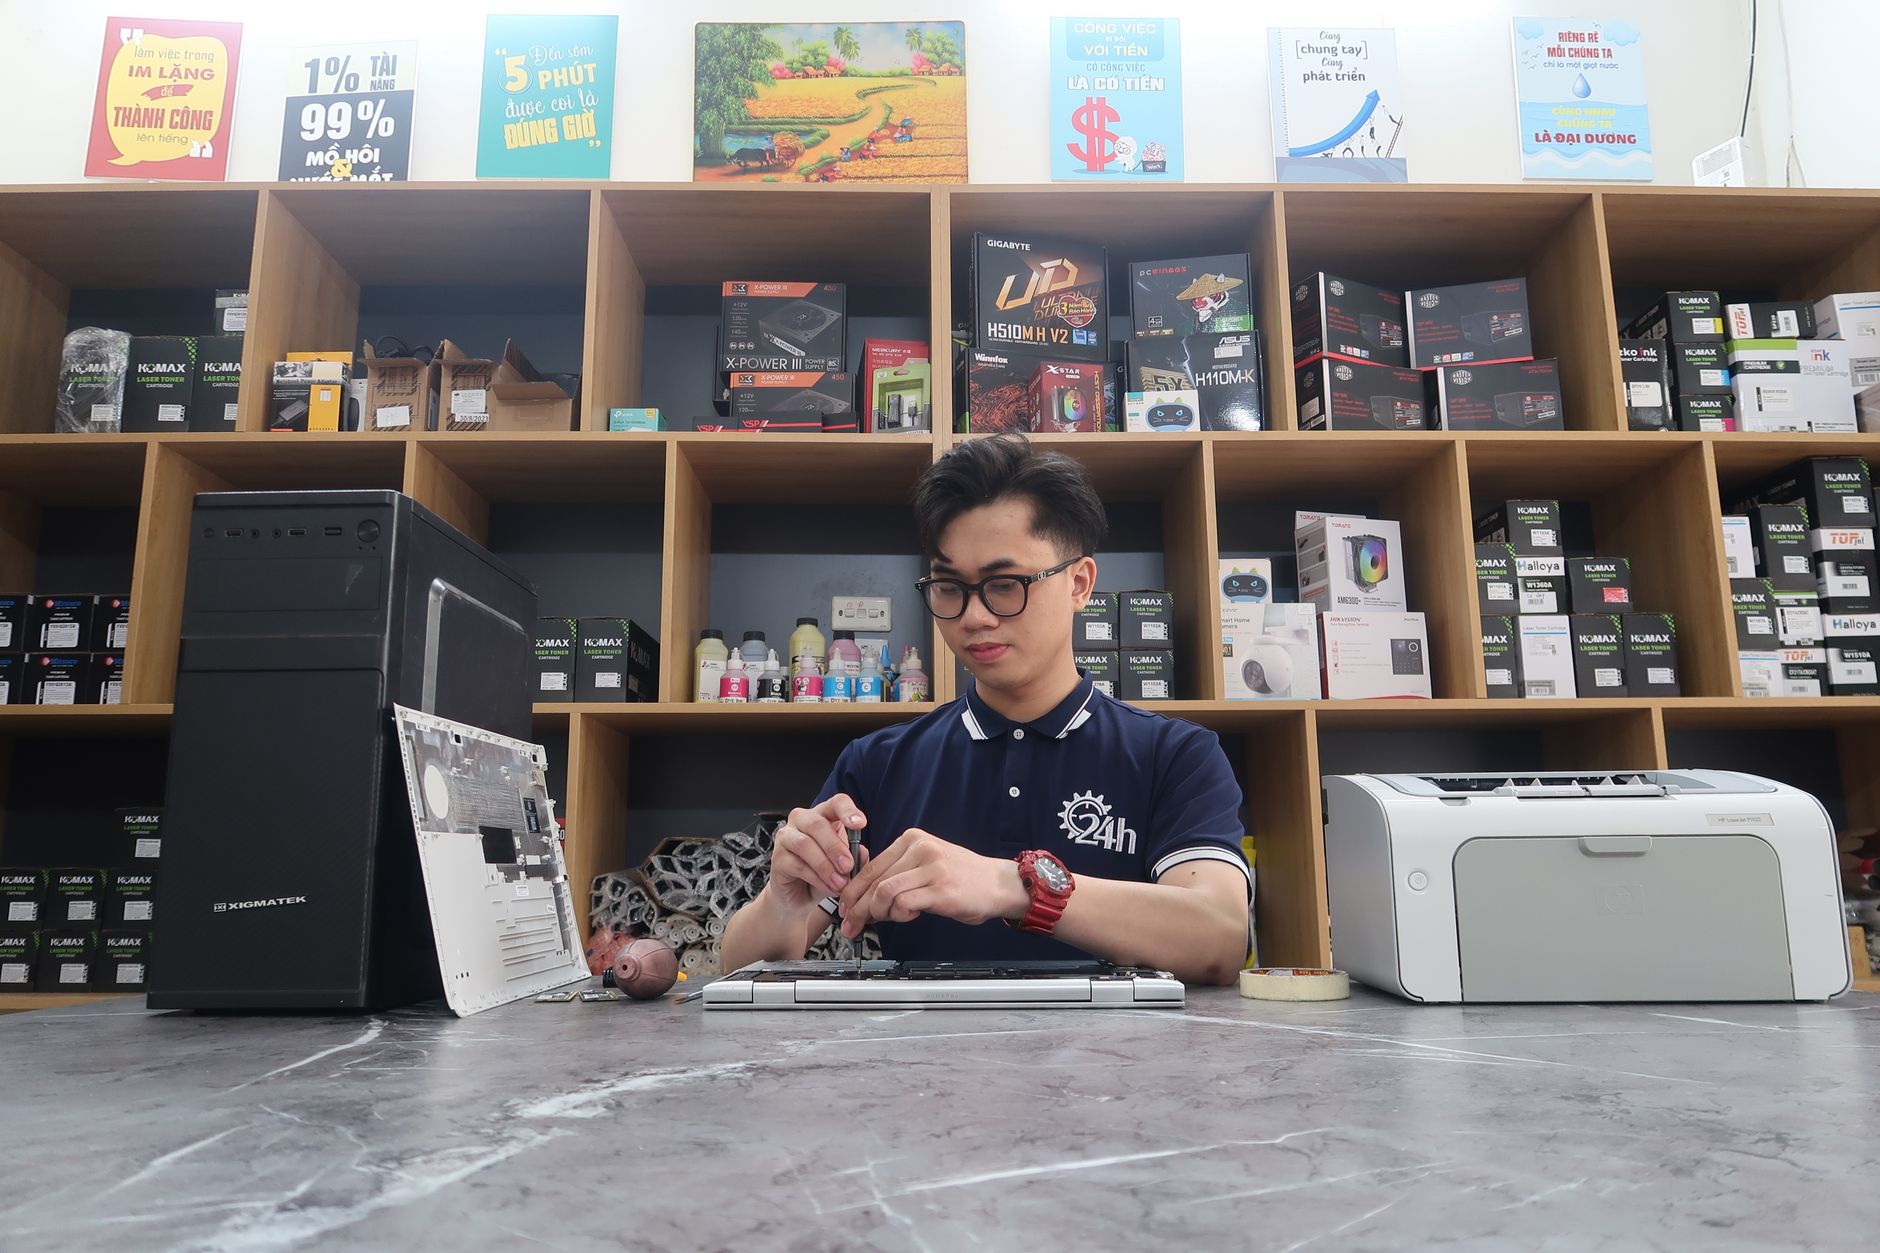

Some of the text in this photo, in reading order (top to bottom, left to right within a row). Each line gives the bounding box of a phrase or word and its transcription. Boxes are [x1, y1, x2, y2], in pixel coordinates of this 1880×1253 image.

[1073, 20, 1117, 33] CÔNG
[1558, 31, 1585, 43] RIÊNG
[1568, 46, 1599, 58] CHÚNG
[1602, 48, 1613, 59] TA
[128, 63, 215, 82] IM LẶNG
[304, 51, 398, 94] 1% TÀI
[538, 60, 597, 91] PHÚT
[1303, 66, 1366, 83] phát triển
[505, 87, 600, 118] được coi là
[113, 103, 214, 131] THÀNH CÔNG
[503, 117, 559, 150] ĐÚNG
[1534, 130, 1637, 146] LÀ ĐẠI DƯƠNG
[345, 144, 381, 164] HÔI
[987, 239, 1031, 251] GIGABYTE
[1050, 328, 1069, 344] V2
[1217, 334, 1251, 345] ASUS
[1639, 346, 1657, 357] ink
[726, 357, 802, 370] X-POWER III
[974, 353, 1008, 364] Winnfox
[137, 363, 186, 374] KOMAX
[203, 375, 226, 383] LASER
[1194, 368, 1254, 387] H110M-K
[1690, 400, 1721, 408] KOMAX
[1823, 473, 1860, 481] KOMAX
[1517, 506, 1549, 514] KOMAX
[1768, 523, 1805, 532] KOMAX
[1518, 562, 1560, 573] Halloya
[1130, 598, 1162, 606] KOMAX
[1833, 619, 1877, 633] Halloya
[584, 638, 622, 647] KOMAX
[1579, 634, 1617, 643] KOMAX
[1630, 634, 1670, 643] KOMAX
[1075, 655, 1108, 664] KOMAX
[1130, 655, 1162, 663] KOMAX
[1074, 812, 1137, 854] 24h
[1, 876, 35, 884] KOMAX
[228, 896, 306, 910] XIGMATEK
[50, 938, 84, 946] KOMAX
[107, 938, 141, 946] KOMAX
